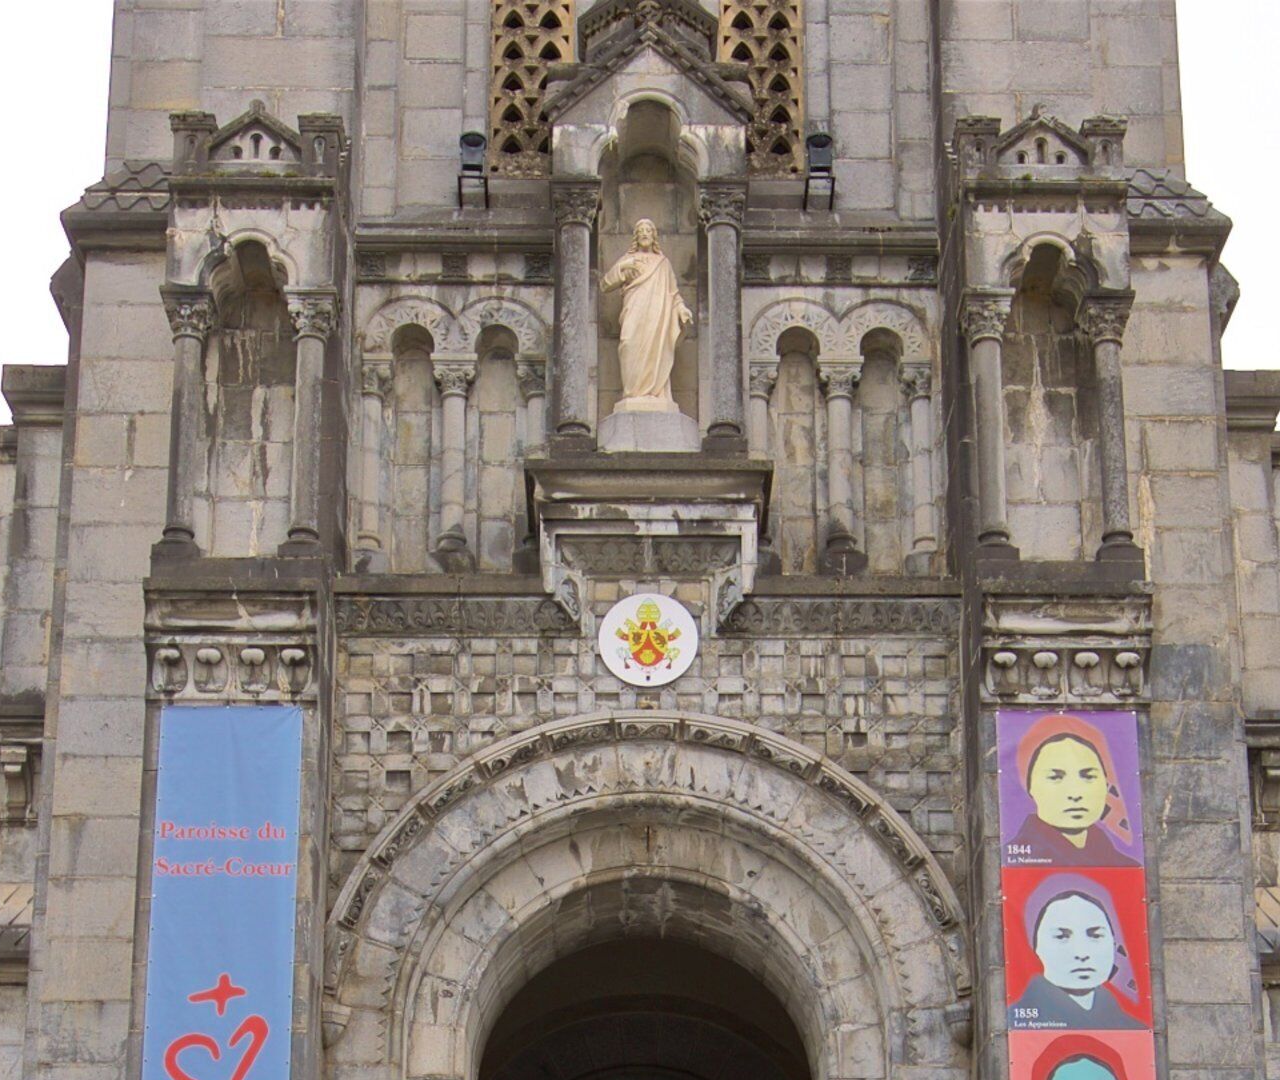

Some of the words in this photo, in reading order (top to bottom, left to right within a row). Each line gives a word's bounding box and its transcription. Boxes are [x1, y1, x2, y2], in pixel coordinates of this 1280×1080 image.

[159, 820, 250, 840] Paroisse
[257, 820, 287, 840] du
[1007, 844, 1031, 855] 1844
[155, 856, 293, 877] Sacré-Coeur
[1014, 1008, 1039, 1018] 1858
